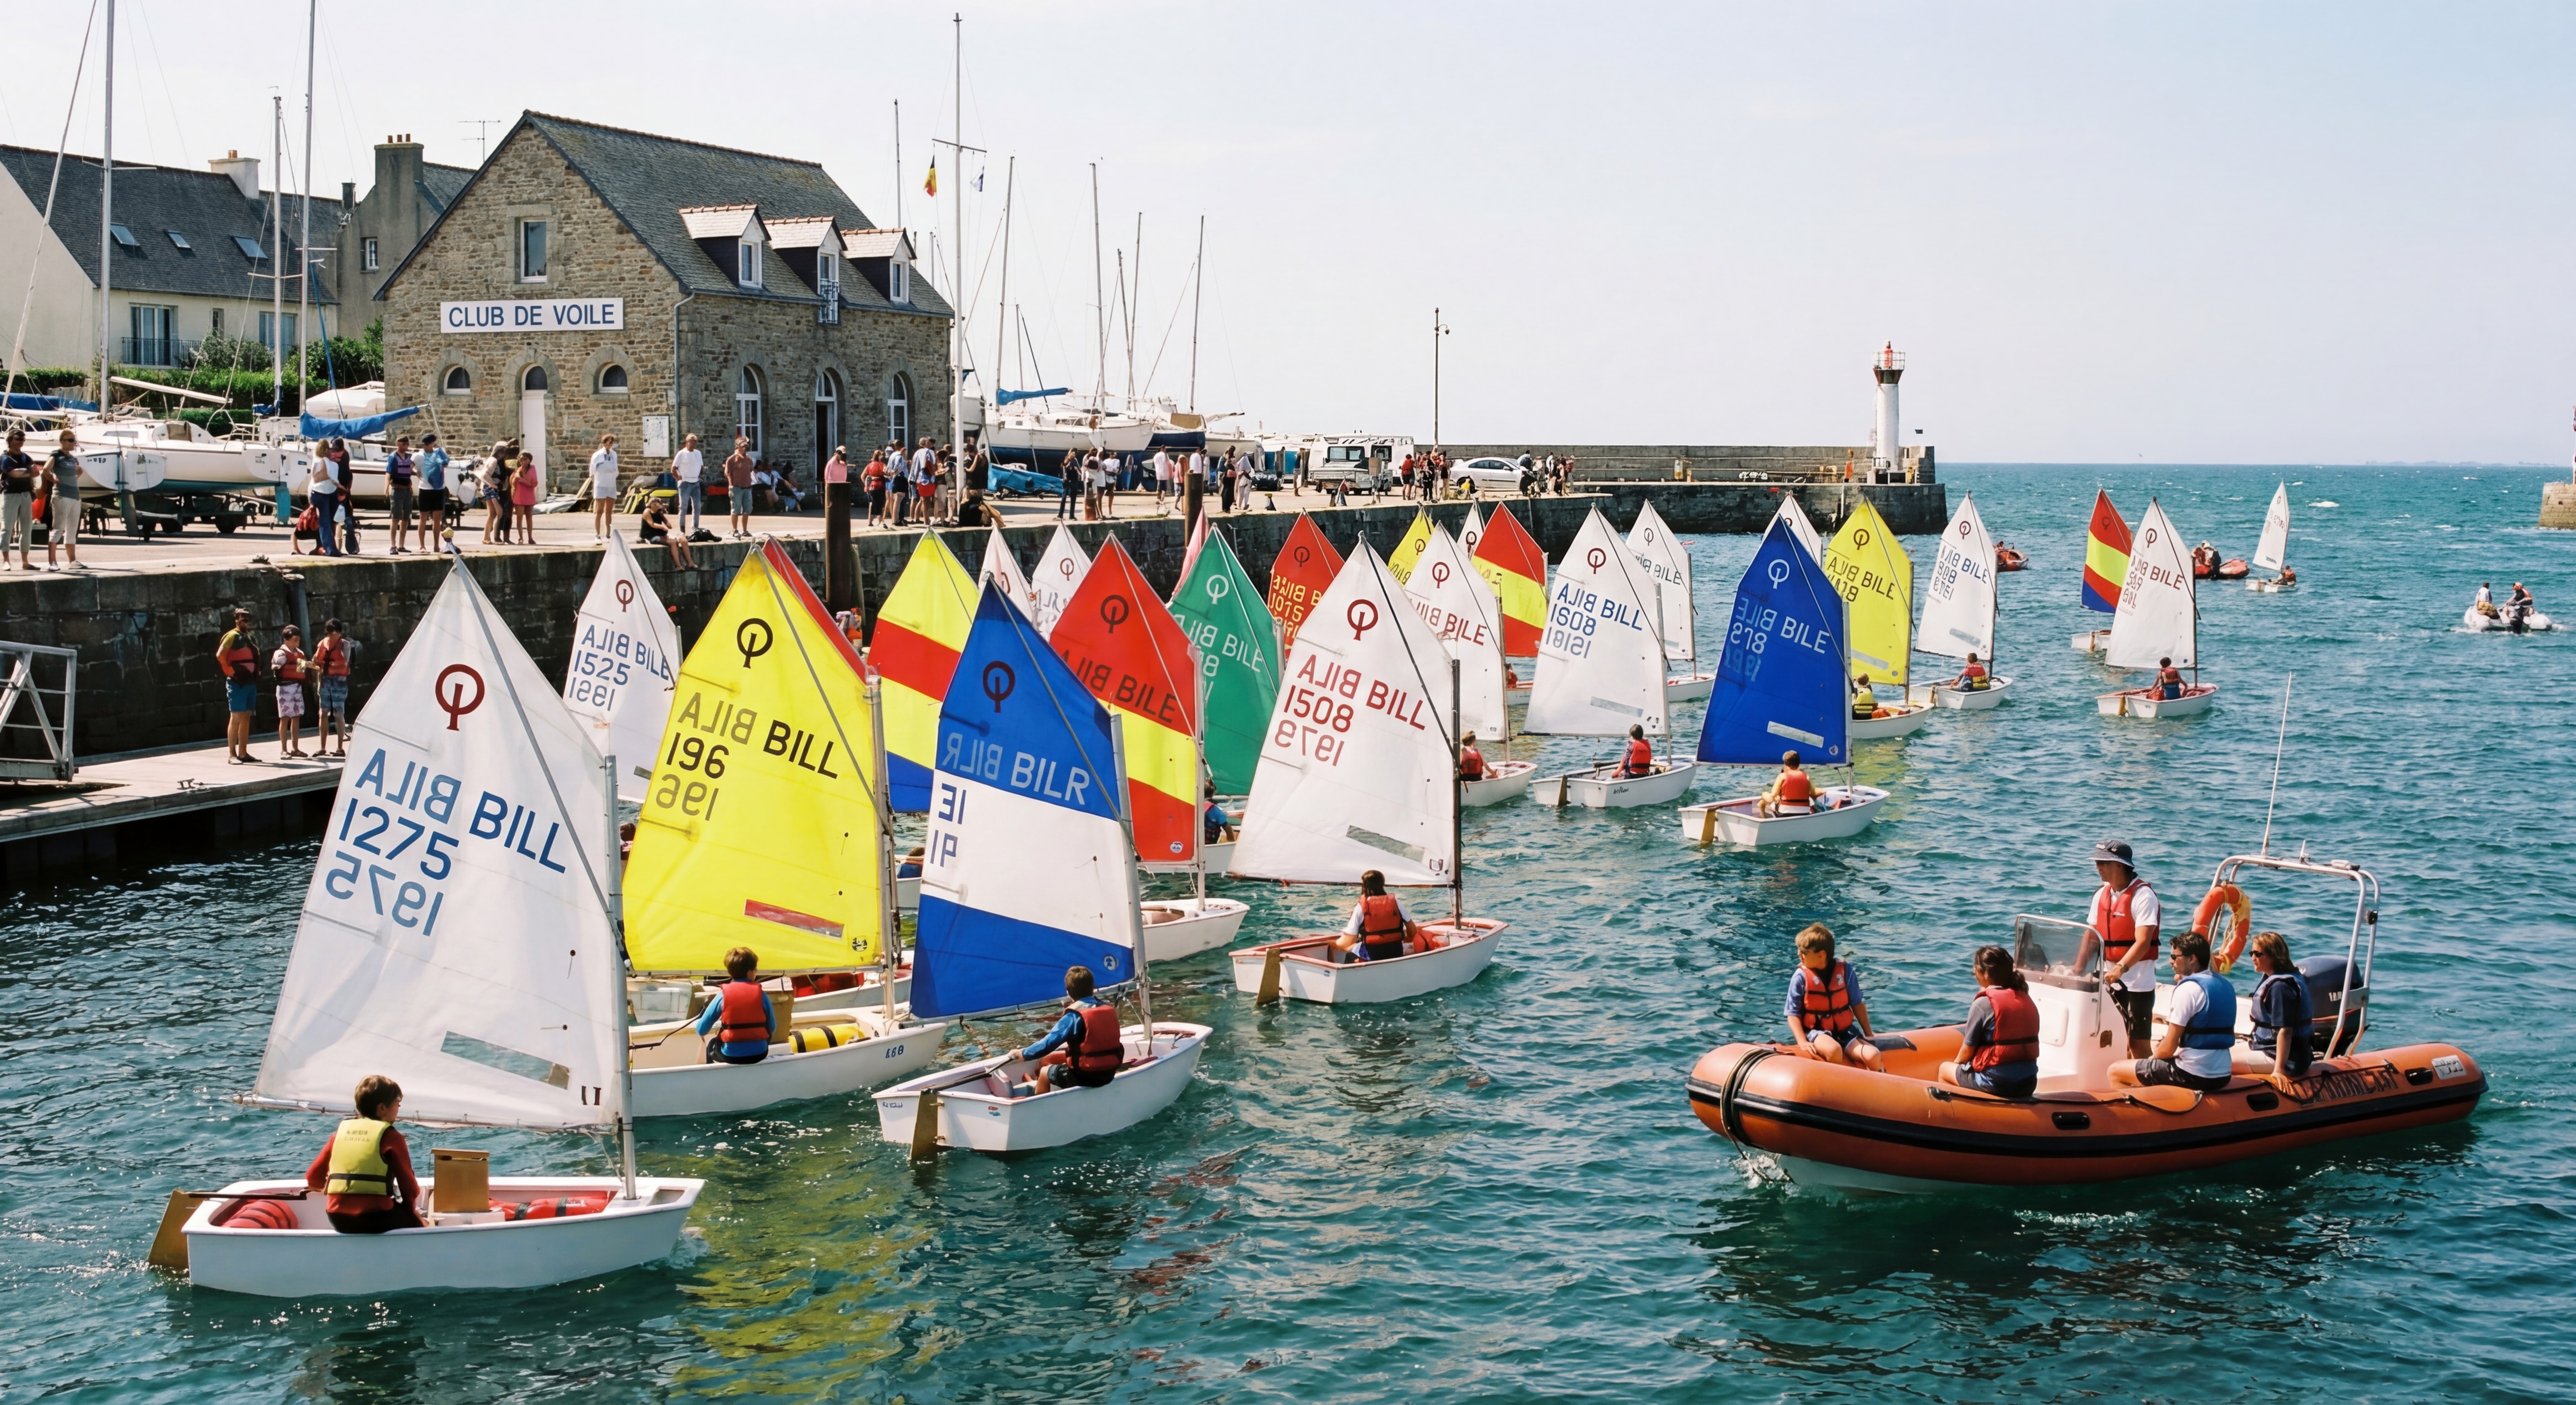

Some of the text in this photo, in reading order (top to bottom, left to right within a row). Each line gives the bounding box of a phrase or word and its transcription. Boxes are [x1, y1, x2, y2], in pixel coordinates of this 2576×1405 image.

[449, 304, 615, 327] CLUB DE VOILE
[1861, 570, 1895, 600] BILE
[1961, 558, 1988, 584] BILE
[2150, 566, 2184, 590] BILE
[1444, 612, 1487, 646] BILE
[1600, 599, 1642, 631] BILL
[1780, 616, 1830, 654] BILE
[574, 650, 631, 686] 1525
[1221, 633, 1263, 673] BILE
[1115, 674, 1177, 724] BILE
[1283, 685, 1354, 733] 1508
[1365, 679, 1426, 731] BILL
[666, 732, 730, 779] 196
[762, 719, 838, 779] BILL
[1010, 751, 1090, 805] BILR
[338, 797, 460, 880] 1275
[468, 790, 566, 874] BILL
